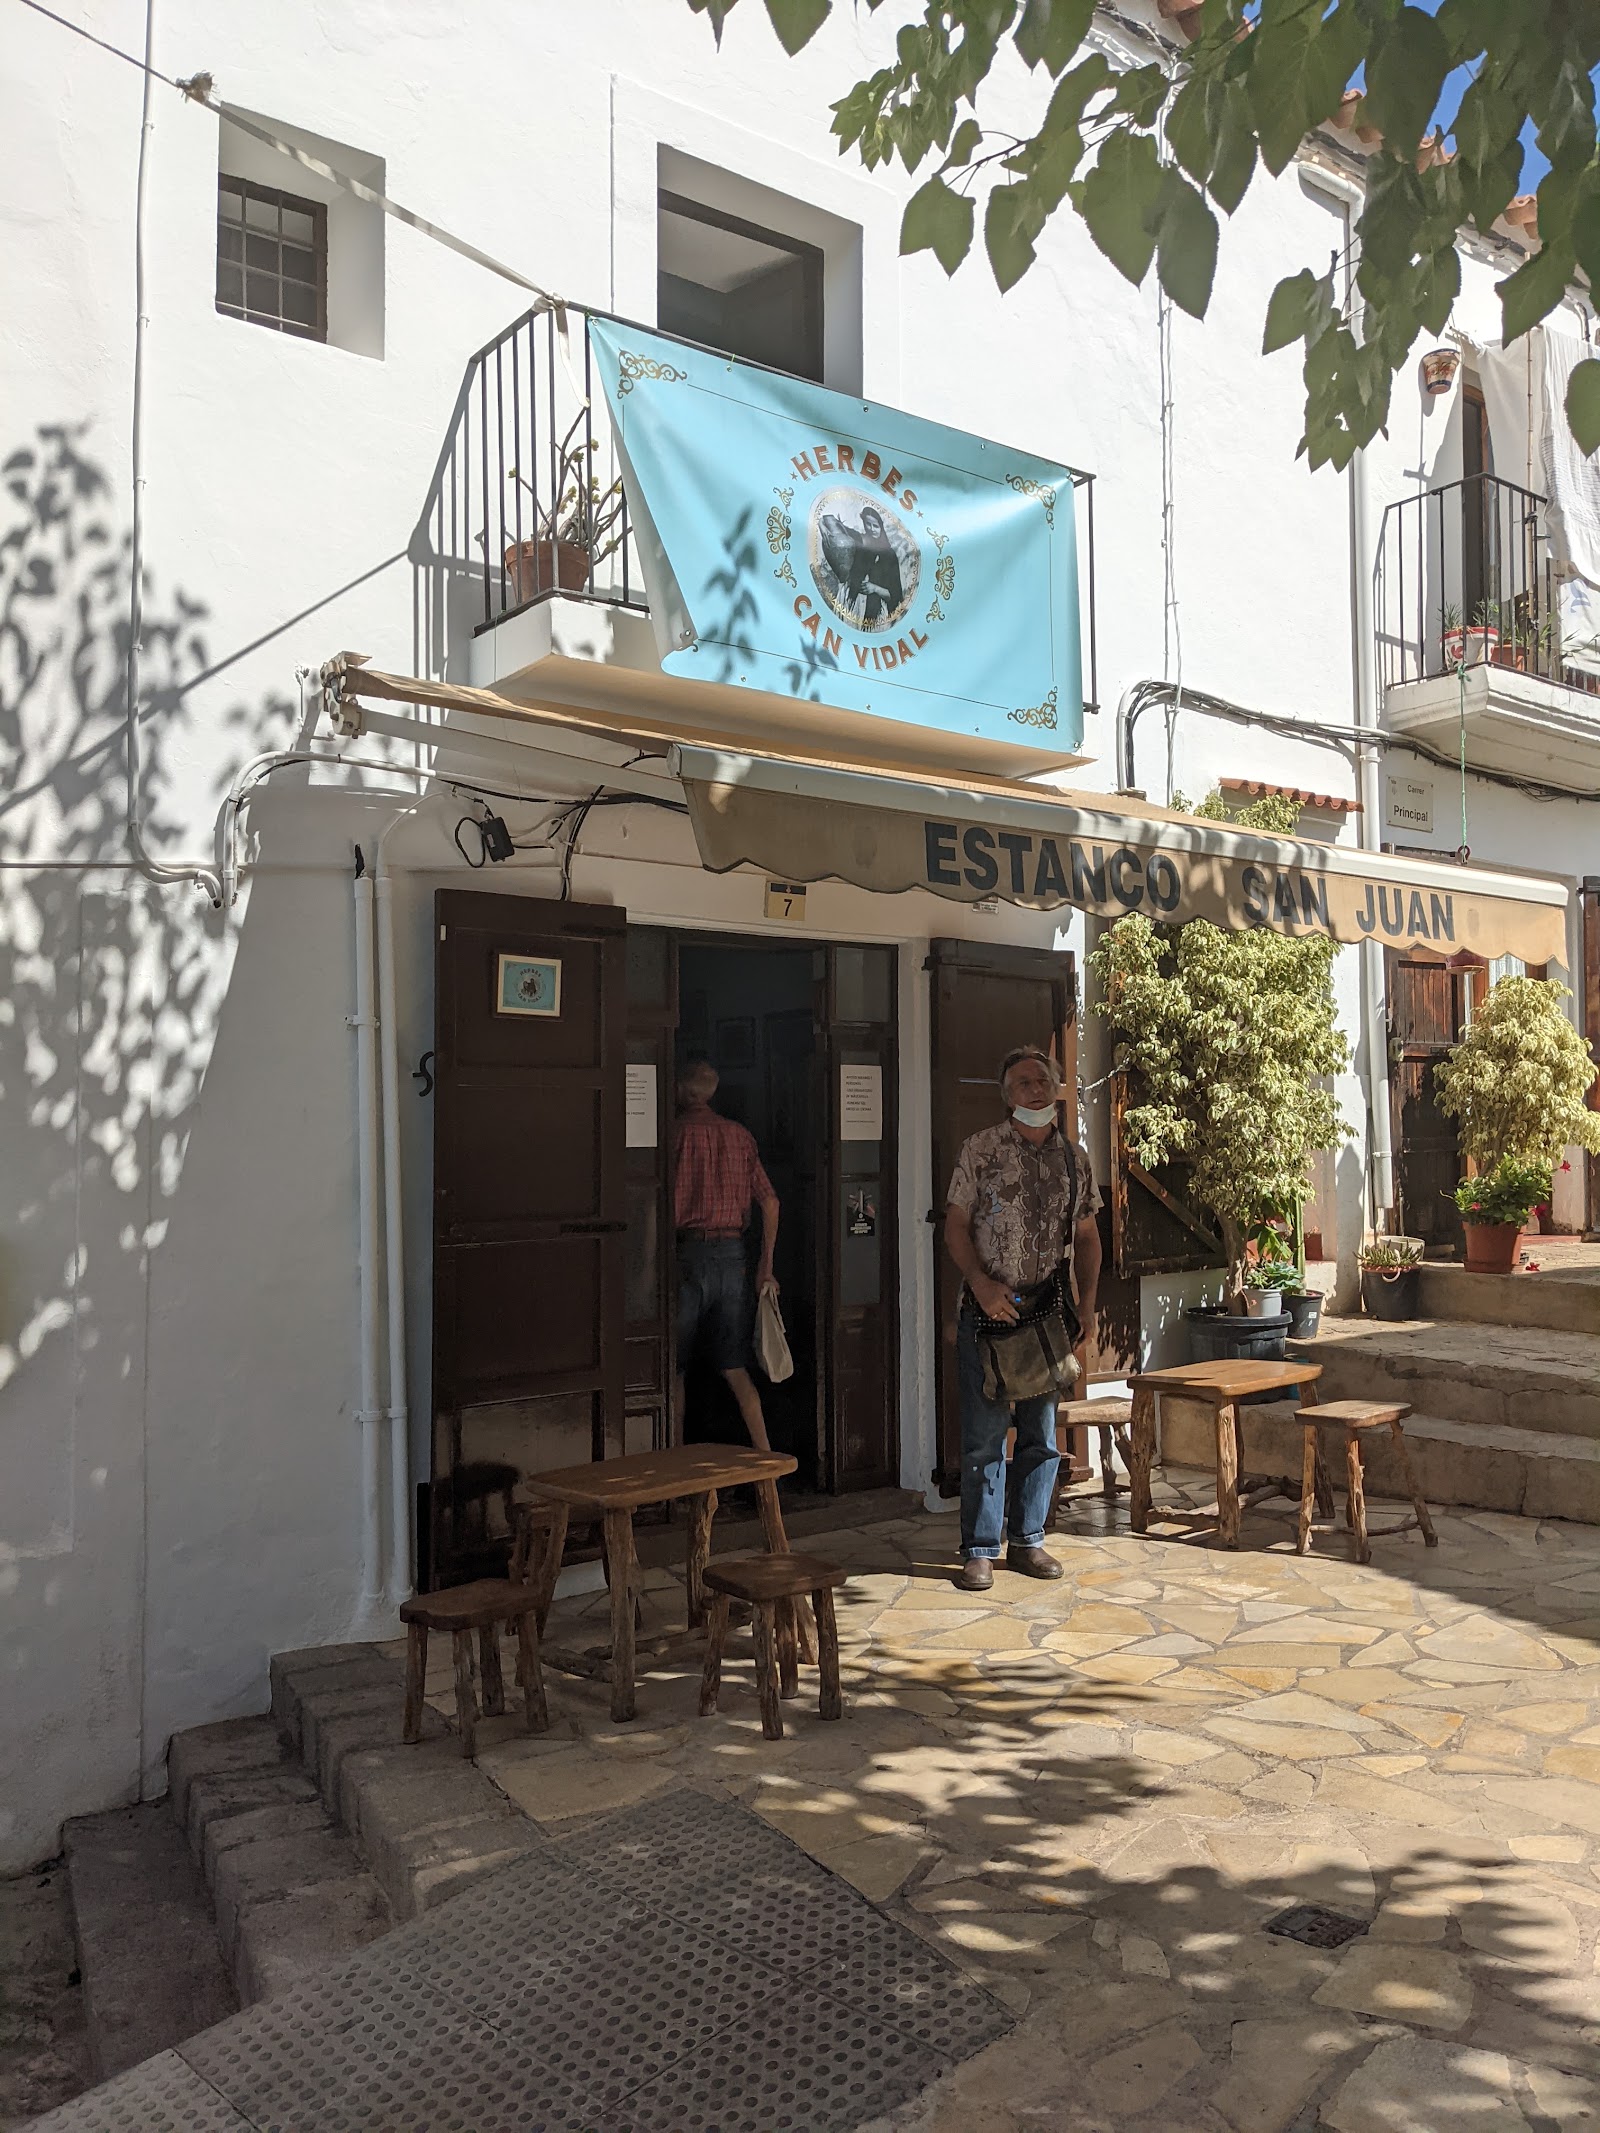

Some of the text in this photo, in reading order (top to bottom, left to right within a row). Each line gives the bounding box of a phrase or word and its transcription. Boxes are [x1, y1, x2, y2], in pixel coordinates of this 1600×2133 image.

[791, 444, 918, 512] HERBES
[793, 594, 929, 671] CAN VIDAL
[1407, 784, 1425, 795] Carrer
[1393, 804, 1429, 822] Principal
[924, 820, 1456, 942] ESTANCO SAN JUAN
[784, 898, 793, 917] 7
